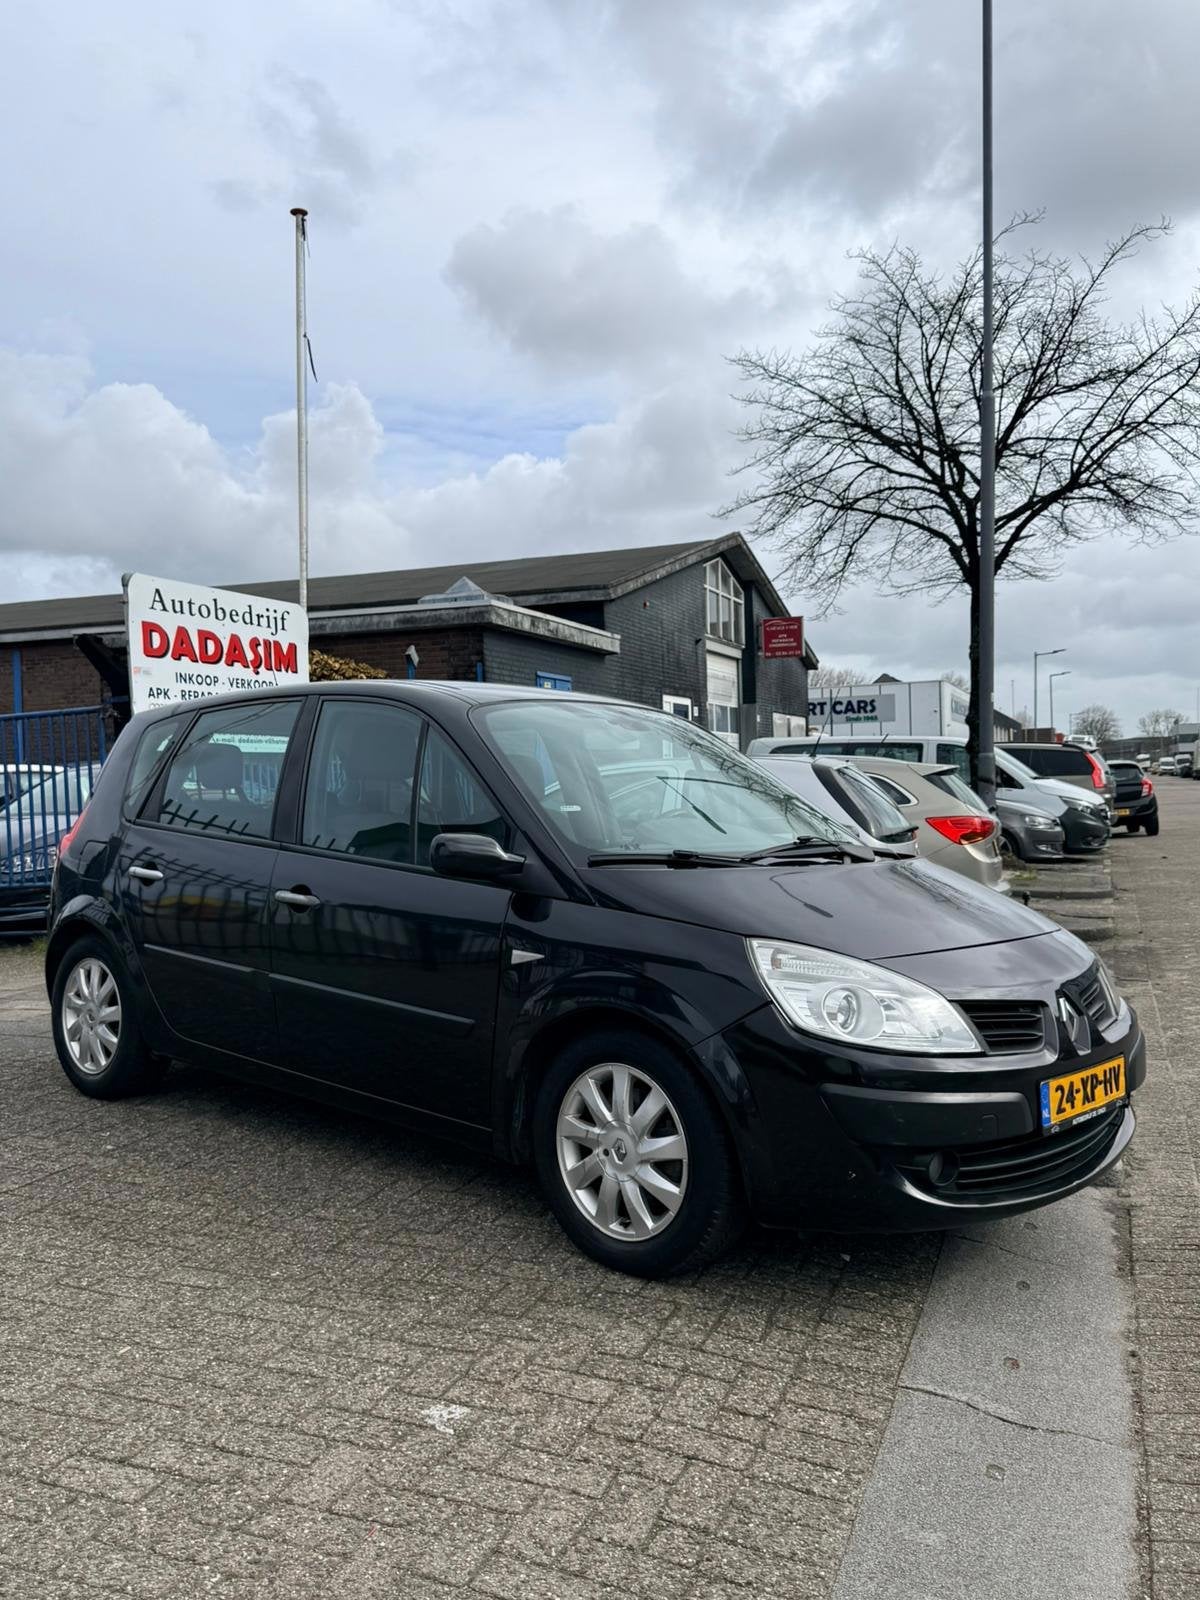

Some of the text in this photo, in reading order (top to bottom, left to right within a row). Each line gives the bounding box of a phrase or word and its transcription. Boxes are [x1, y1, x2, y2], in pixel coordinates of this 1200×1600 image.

[149, 588, 290, 636] Autobedrijf
[175, 672, 219, 687] INKOOP
[148, 687, 171, 700] APK
[831, 699, 876, 715] CARS
[1055, 1064, 1121, 1116] 24-XP-HV
